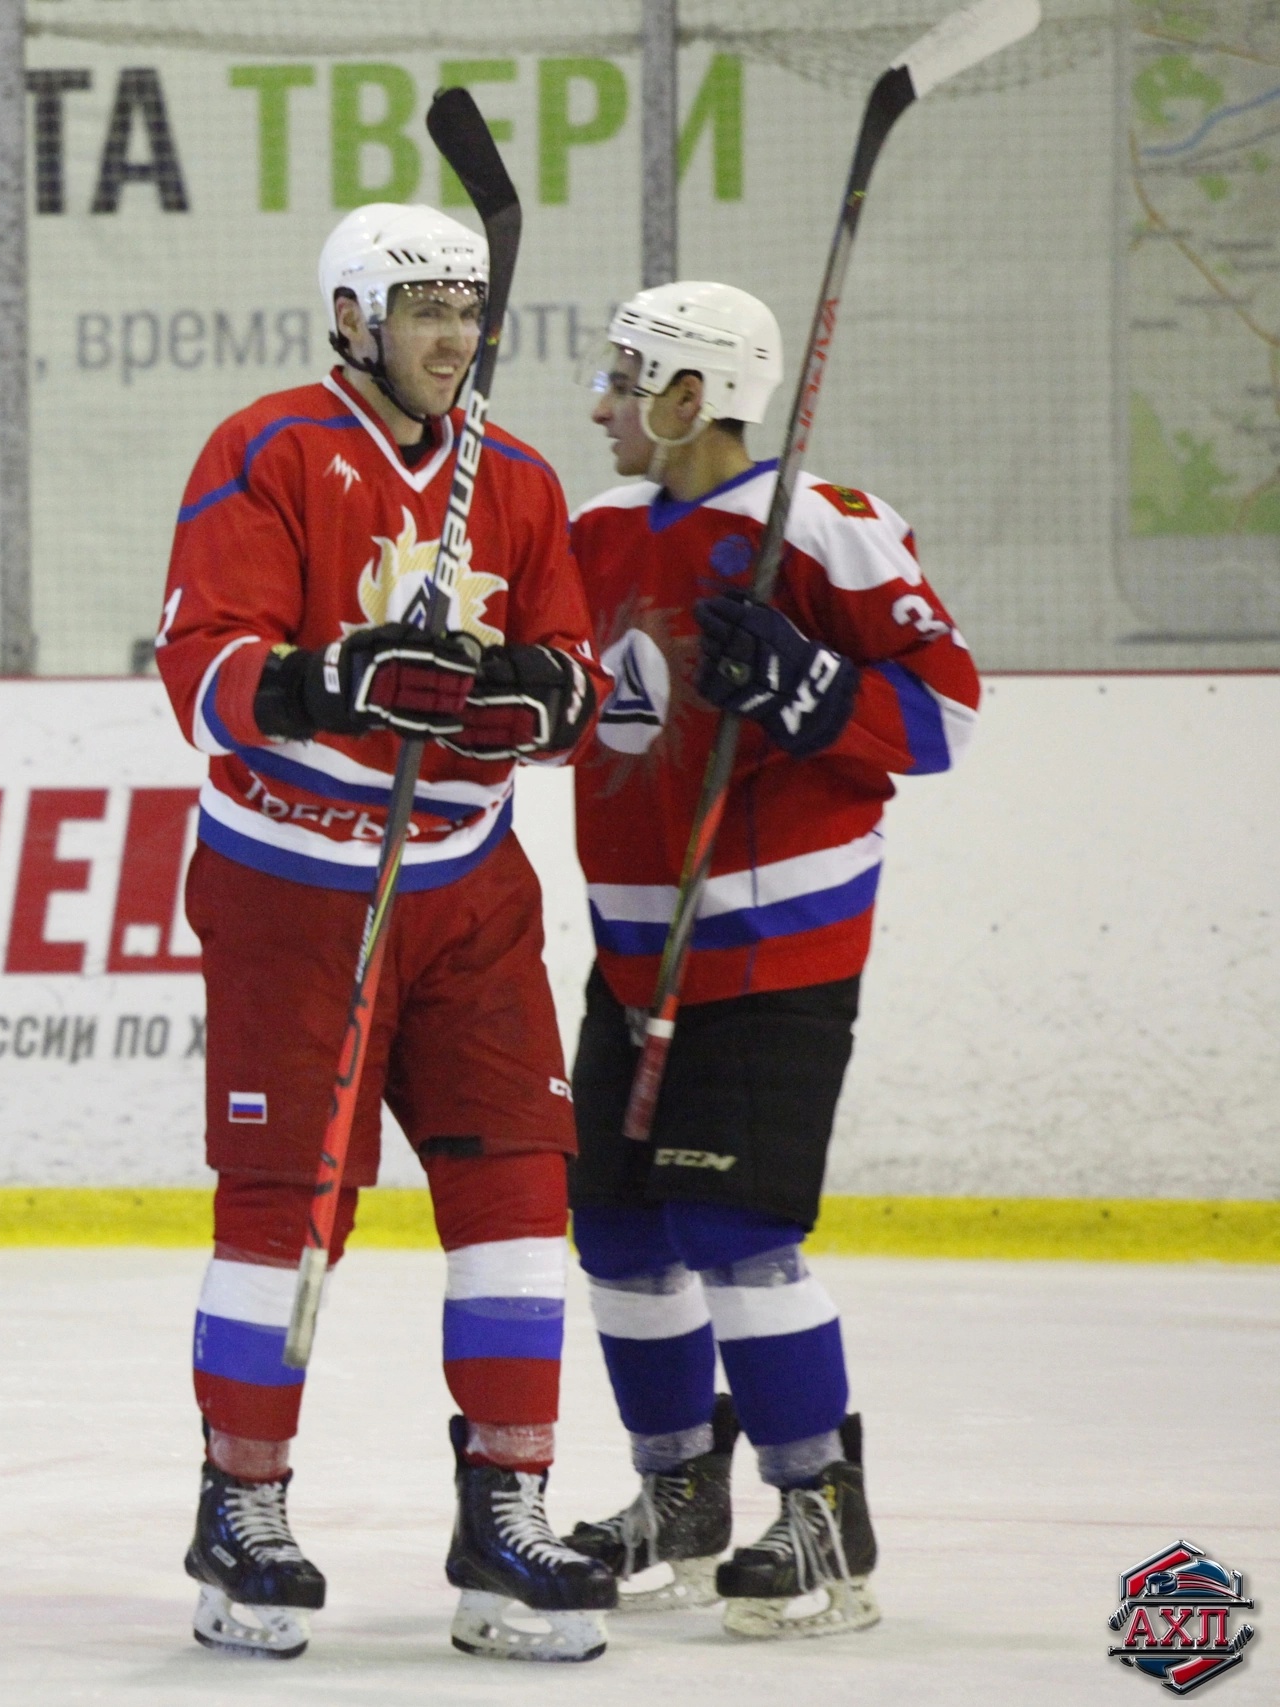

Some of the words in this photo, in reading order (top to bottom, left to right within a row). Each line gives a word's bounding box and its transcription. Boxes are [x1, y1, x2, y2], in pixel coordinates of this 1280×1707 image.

[76, 308, 312, 386] время
[115, 1016, 169, 1059] ПО
[653, 1148, 737, 1172] CCM
